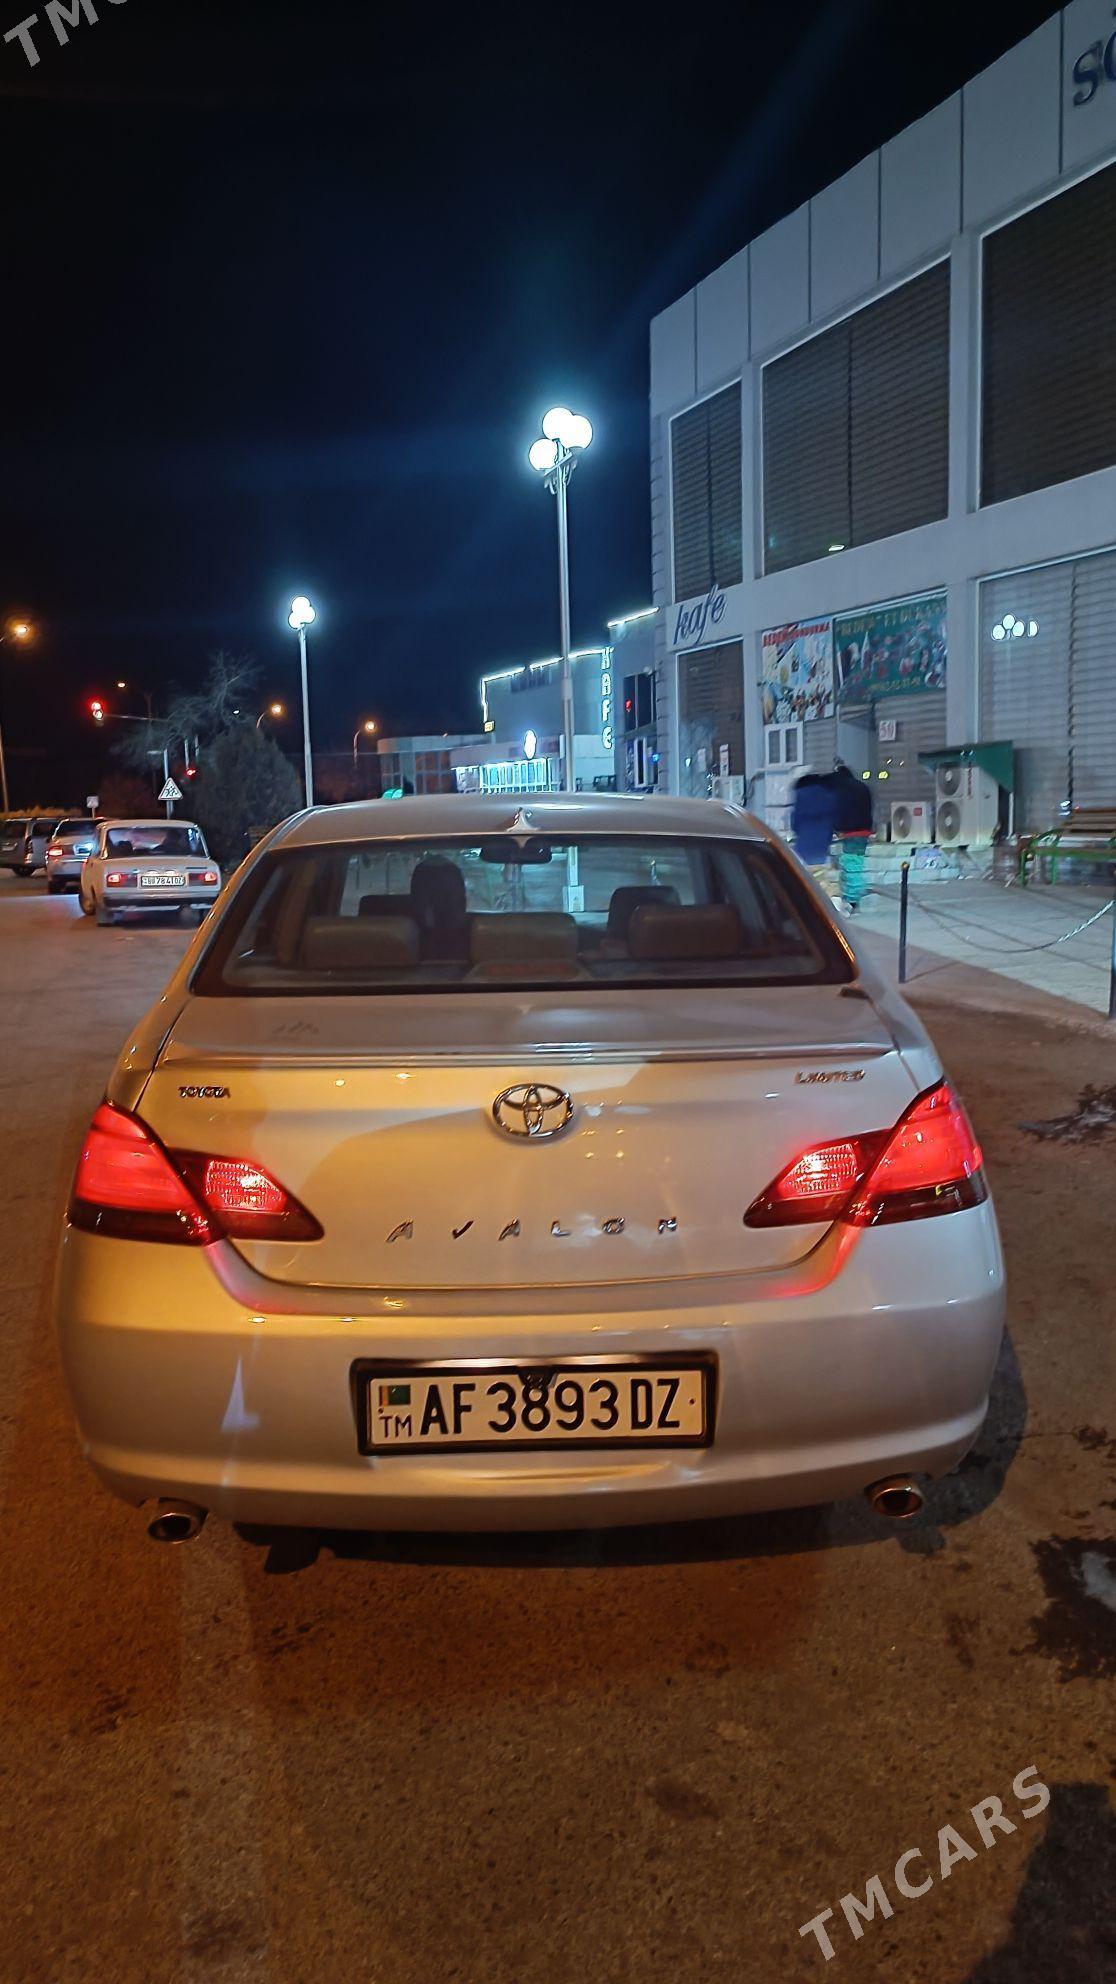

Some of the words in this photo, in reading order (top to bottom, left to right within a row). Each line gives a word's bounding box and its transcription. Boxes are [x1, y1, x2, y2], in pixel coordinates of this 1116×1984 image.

[673, 583, 727, 648] kafe
[178, 1086, 231, 1098] TOYOTA
[385, 1216, 679, 1243] AVALON
[420, 1383, 477, 1436] AF
[486, 1379, 619, 1433] 3893
[630, 1378, 681, 1430] DZ
[379, 1414, 412, 1438] TM
